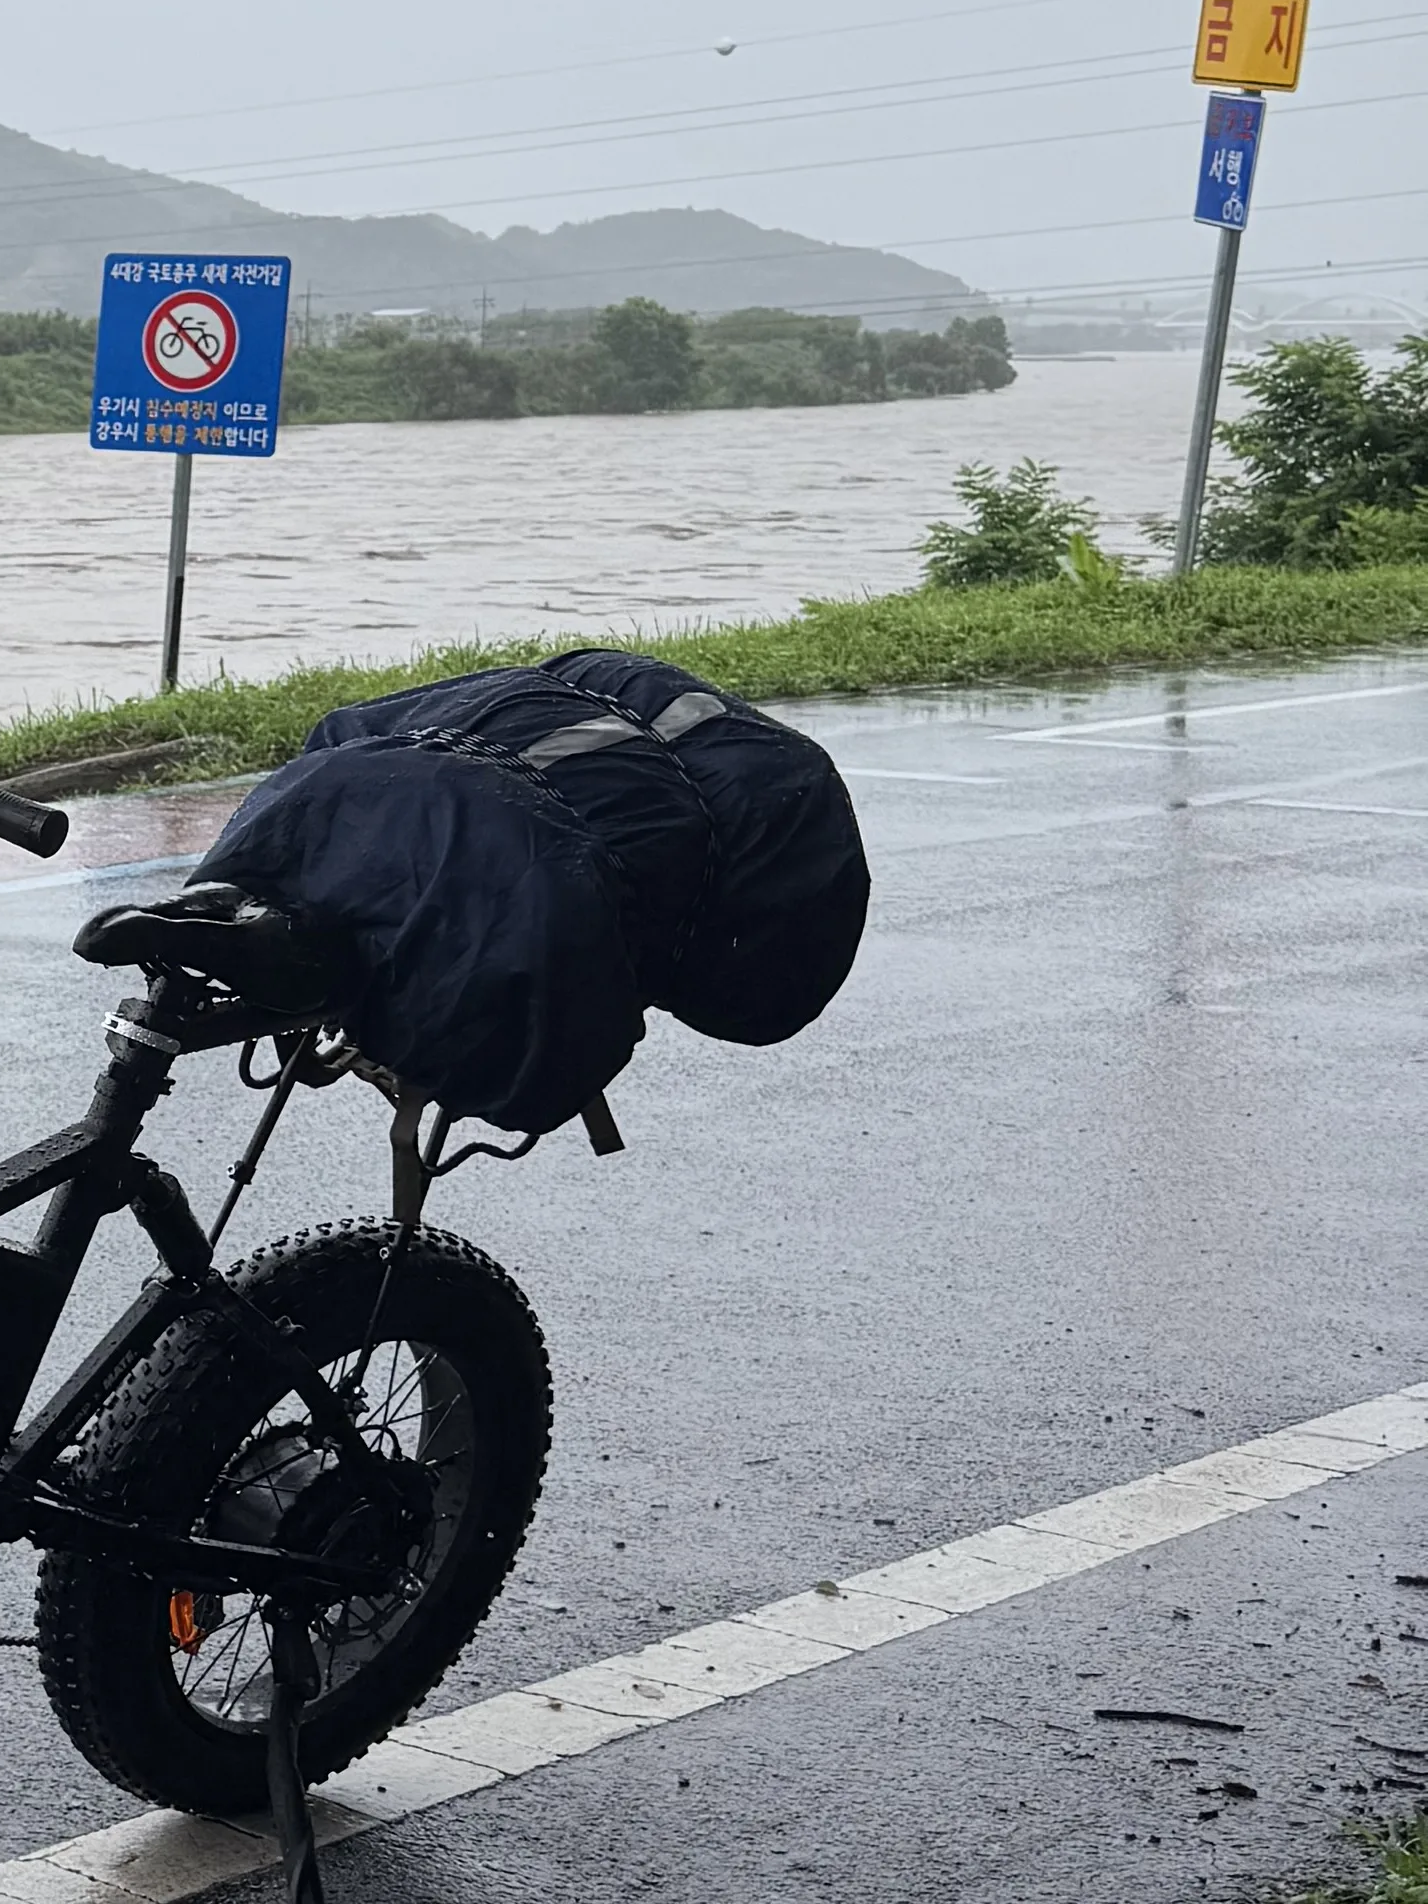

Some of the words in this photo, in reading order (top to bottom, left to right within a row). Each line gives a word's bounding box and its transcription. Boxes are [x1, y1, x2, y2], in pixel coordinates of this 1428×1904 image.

[1208, 148, 1244, 185] 서행
[110, 262, 145, 282] 4대강
[231, 264, 283, 286] 자전거길
[97, 396, 140, 418] 우기시
[223, 401, 268, 422] 이므로
[96, 421, 139, 442] 강우시
